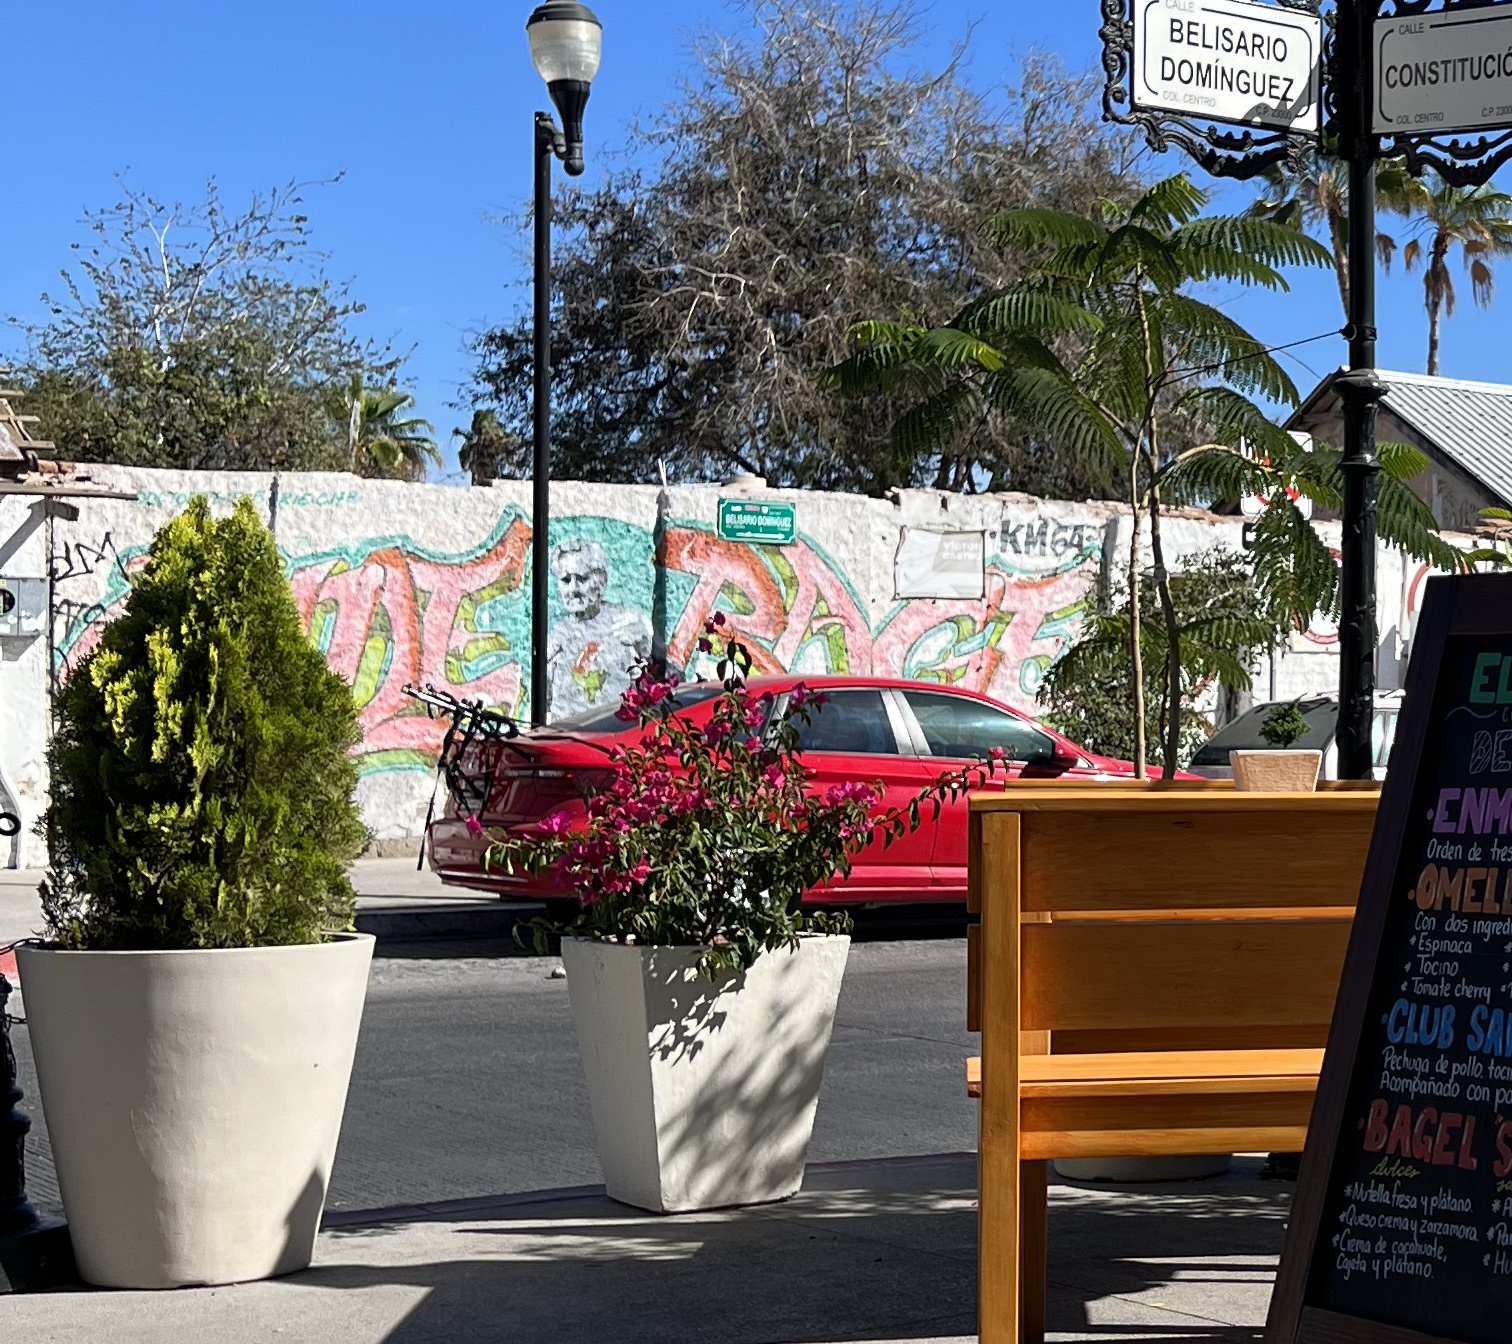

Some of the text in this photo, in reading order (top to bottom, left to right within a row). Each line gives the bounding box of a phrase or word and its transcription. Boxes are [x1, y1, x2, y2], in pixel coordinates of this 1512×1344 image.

[1169, 17, 1288, 64] BELISARIO
[1398, 22, 1425, 35] CALLE
[1160, 55, 1295, 103] DOMÍNGUEZ
[1183, 93, 1217, 108] CENTRO
[1413, 111, 1445, 124] CENTRO
[1426, 837, 1463, 861] Orden
[1467, 841, 1482, 862] de
[1414, 911, 1437, 931] Con
[1444, 913, 1469, 933] dos
[1417, 932, 1473, 959] Espinaca
[1416, 954, 1459, 976] Tocino
[1411, 976, 1492, 1005] Tomate cherry
[1386, 997, 1457, 1050] CLUB
[1382, 1045, 1430, 1079] Pechuga
[1435, 1053, 1449, 1075] de
[1379, 1070, 1460, 1100] Acompañado
[1466, 1083, 1491, 1102] con
[1362, 1097, 1479, 1172] BAGEL
[1368, 1156, 1421, 1179] dulces
[1420, 1195, 1429, 1216] y
[1345, 1204, 1377, 1228] Queso
[1378, 1214, 1409, 1231] crema
[1410, 1219, 1418, 1244] y
[1374, 1235, 1387, 1254] de
[1335, 1253, 1367, 1281] Cajeta
[1371, 1259, 1380, 1280] y
